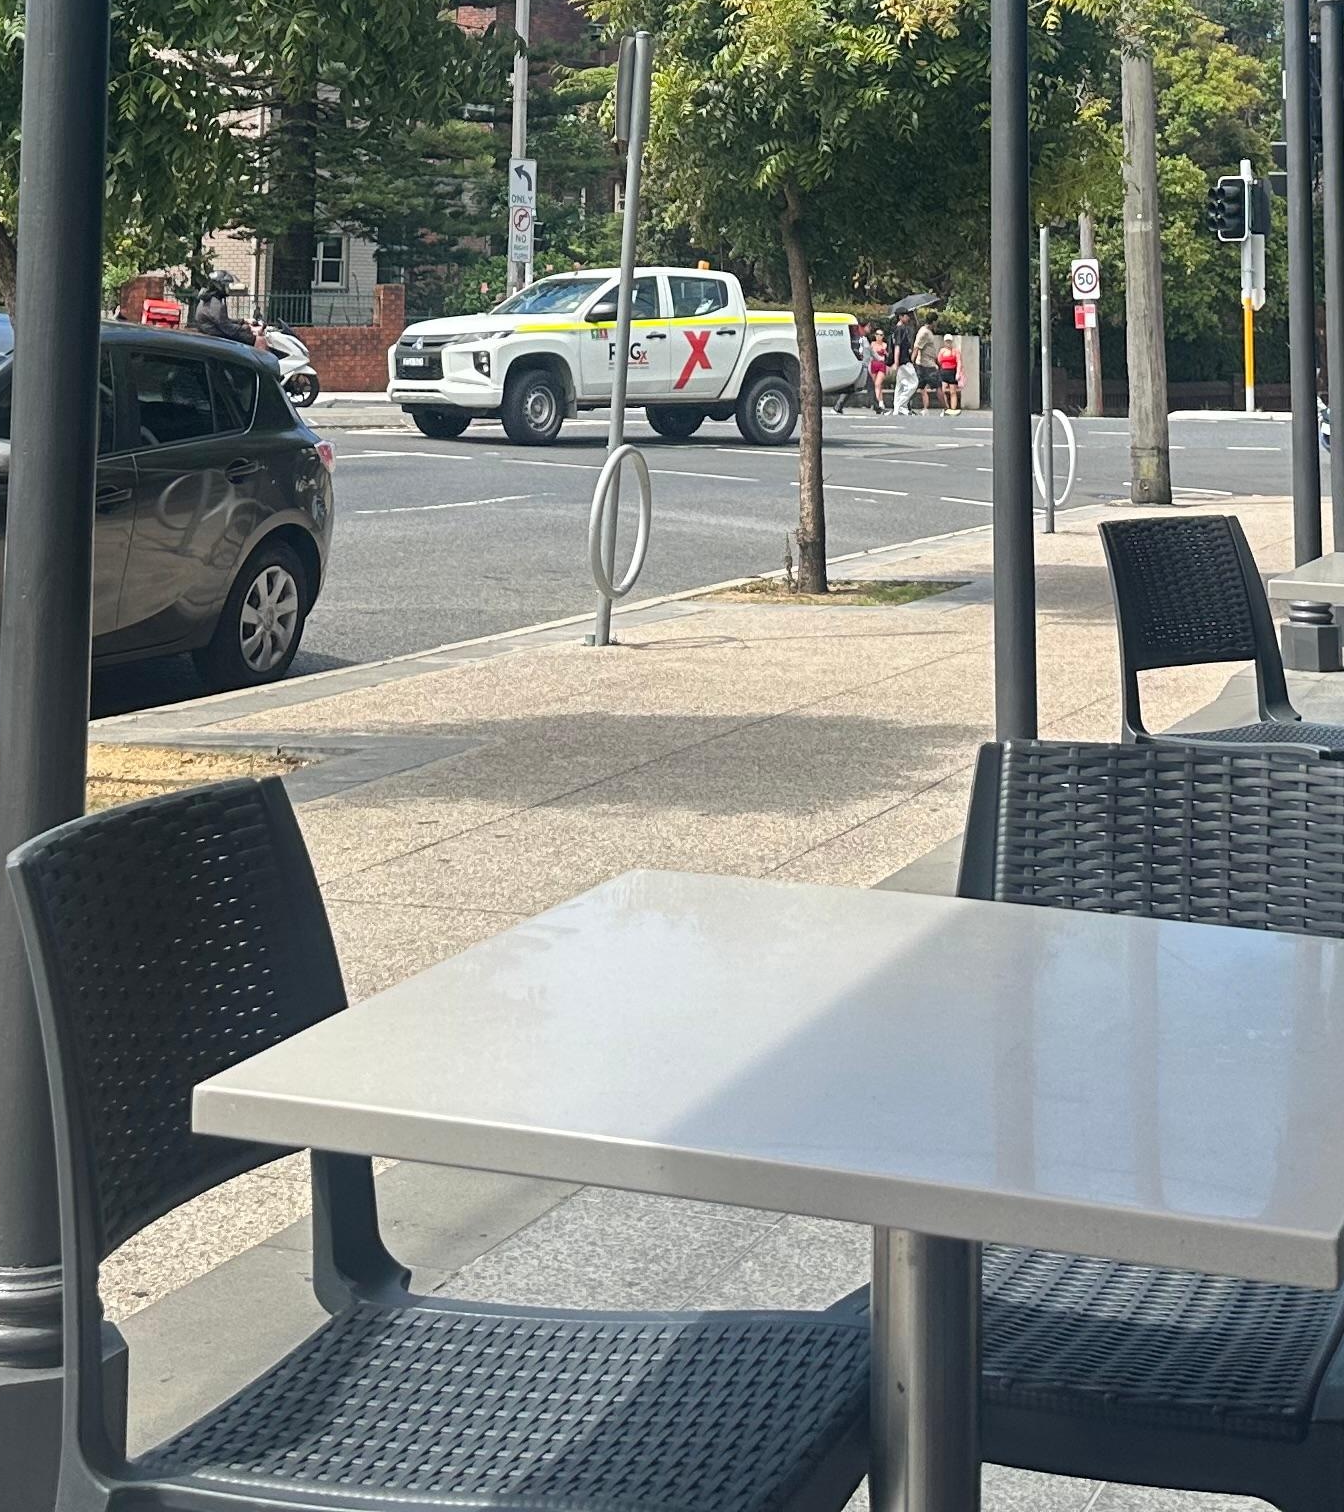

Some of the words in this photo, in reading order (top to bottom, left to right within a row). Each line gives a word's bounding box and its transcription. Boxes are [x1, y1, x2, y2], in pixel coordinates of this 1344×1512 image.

[512, 194, 533, 204] ONLY
[516, 234, 527, 244] NO
[1077, 272, 1094, 286] 50
